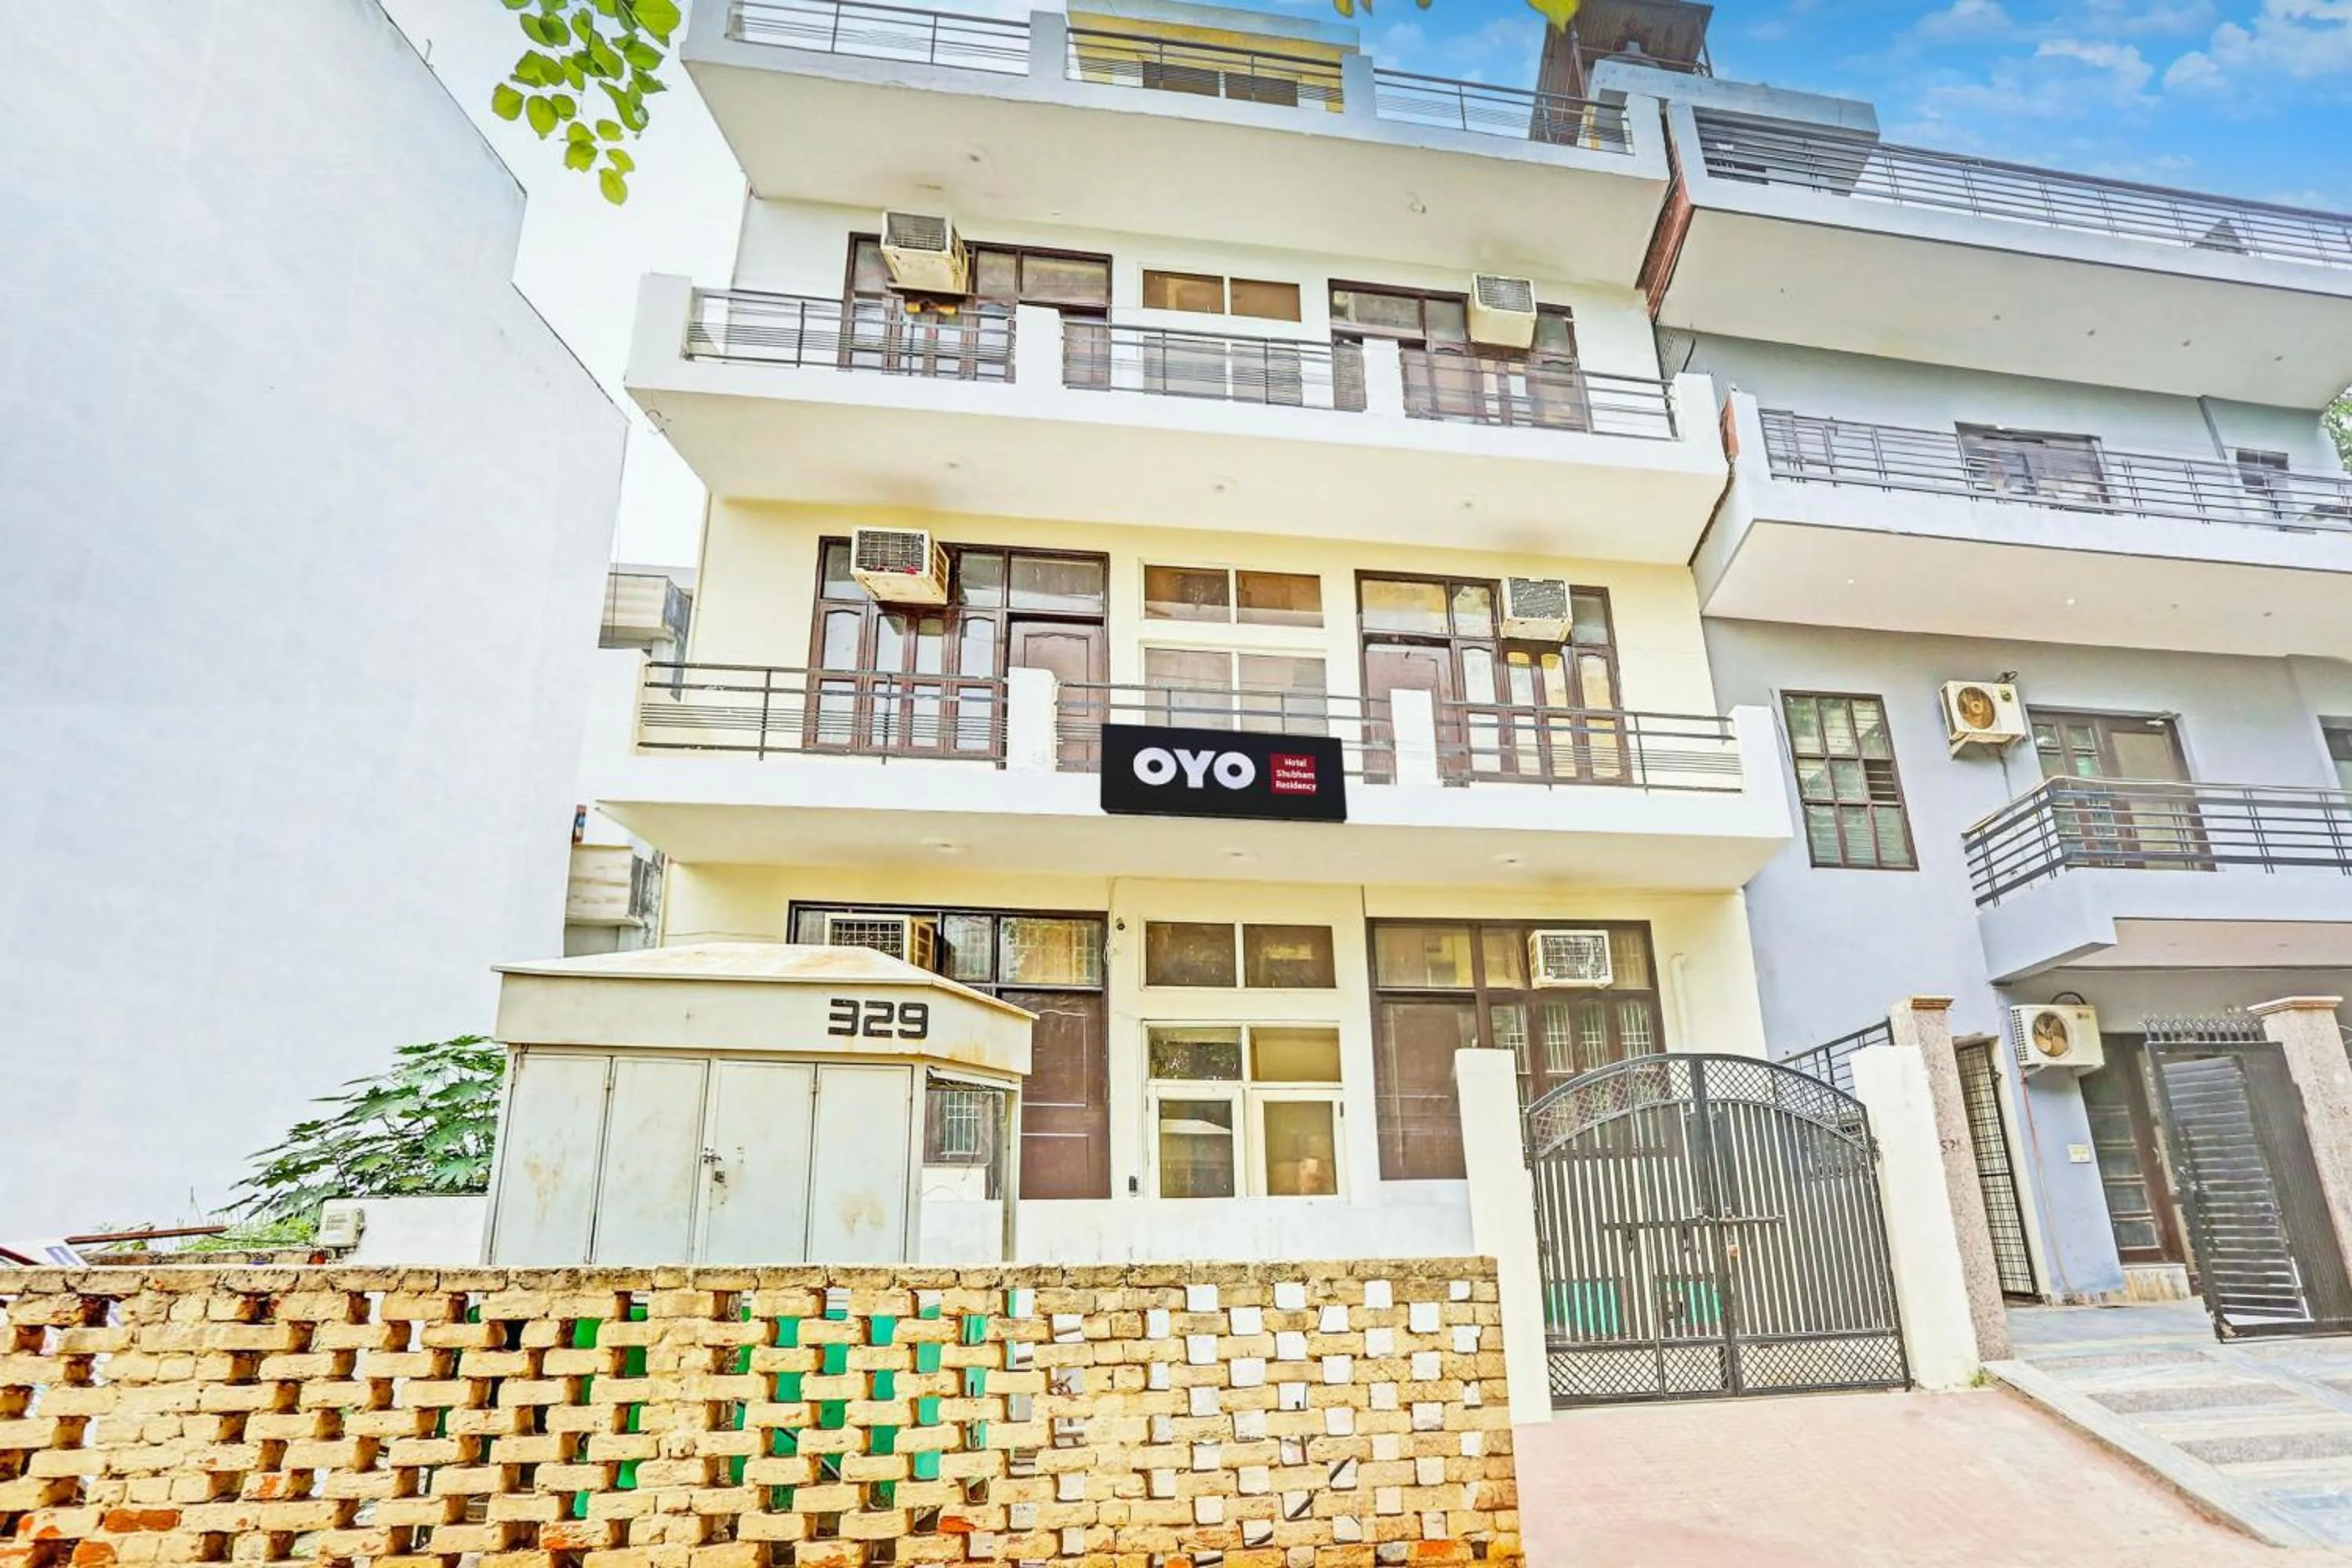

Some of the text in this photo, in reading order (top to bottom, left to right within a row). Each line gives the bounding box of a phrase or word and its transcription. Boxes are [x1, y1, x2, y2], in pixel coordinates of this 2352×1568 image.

[1133, 747, 1256, 789] OYO
[1284, 758, 1307, 768] Hotel
[1276, 769, 1315, 779] Shubham
[1276, 780, 1317, 792] Residency
[828, 998, 929, 1040] 329
